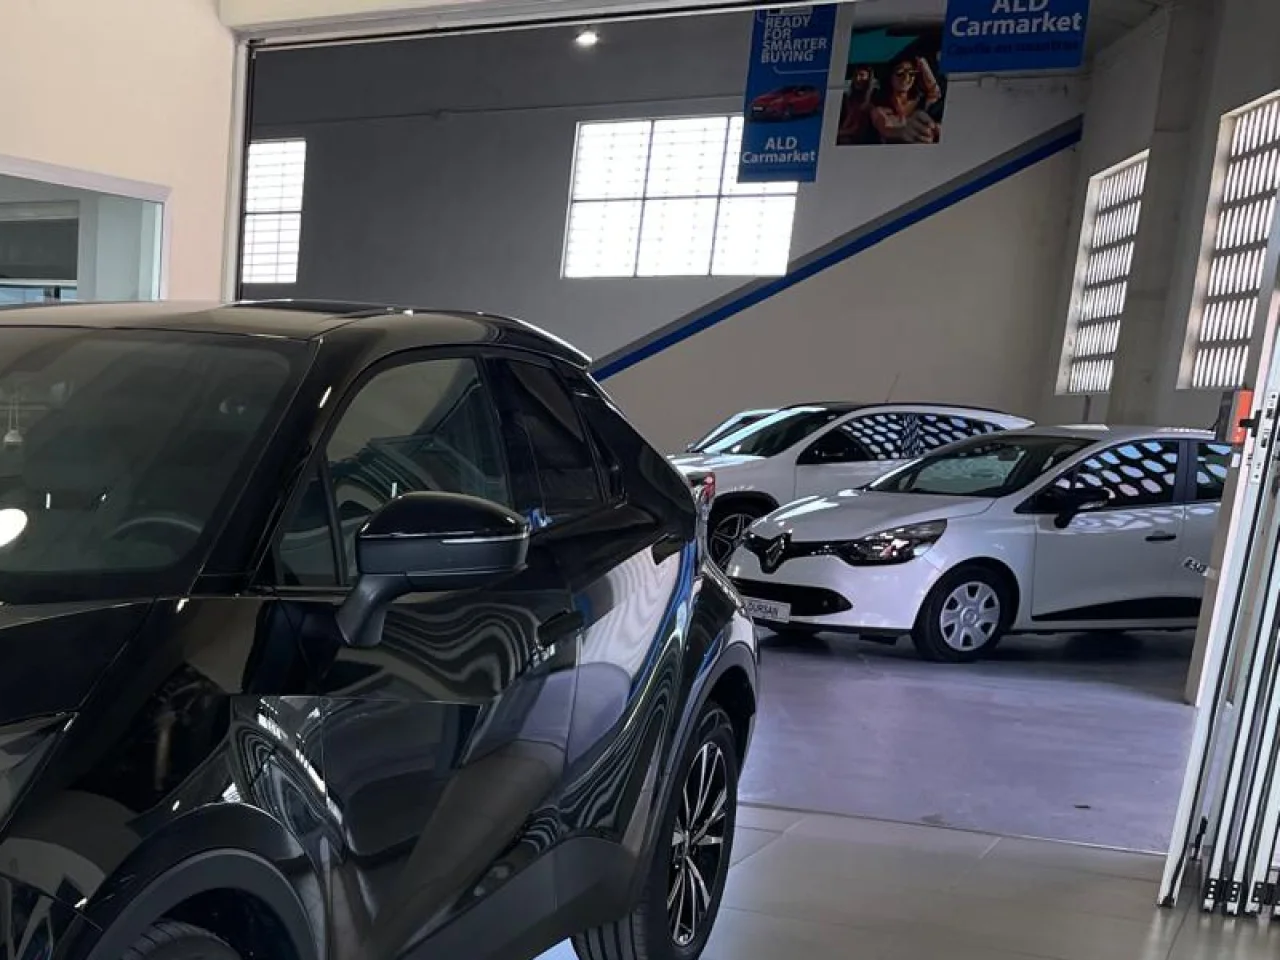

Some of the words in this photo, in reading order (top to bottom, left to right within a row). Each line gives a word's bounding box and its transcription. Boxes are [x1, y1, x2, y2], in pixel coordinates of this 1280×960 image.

[765, 15, 812, 29] READY
[951, 11, 1083, 37] Carmarket
[765, 28, 793, 40] FOR
[762, 38, 828, 52] SMARTER
[761, 50, 814, 64] BUYING
[765, 136, 798, 151] ALD
[741, 150, 816, 164] Carmarket
